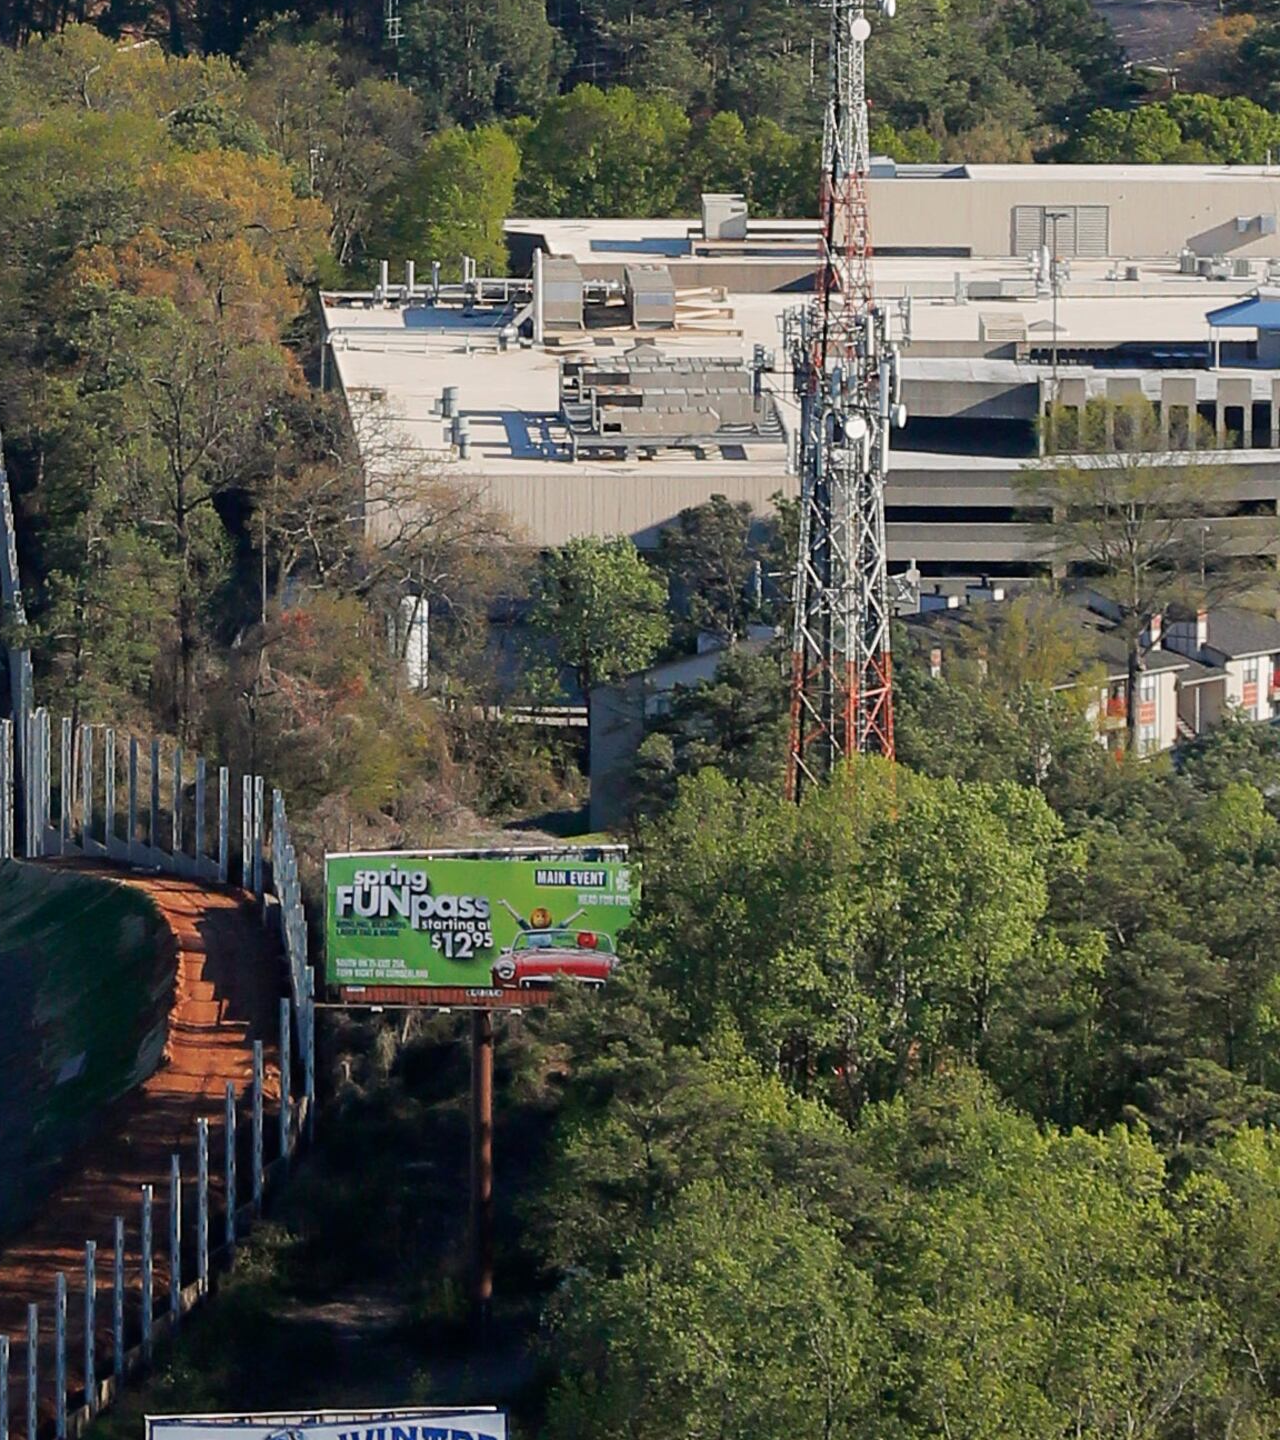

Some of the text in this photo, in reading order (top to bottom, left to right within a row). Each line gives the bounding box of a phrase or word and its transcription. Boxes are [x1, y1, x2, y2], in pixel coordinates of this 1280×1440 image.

[354, 864, 427, 892] spring
[537, 870, 567, 884] MAIN
[569, 870, 605, 885] EVENT
[422, 920, 491, 933] starting at
